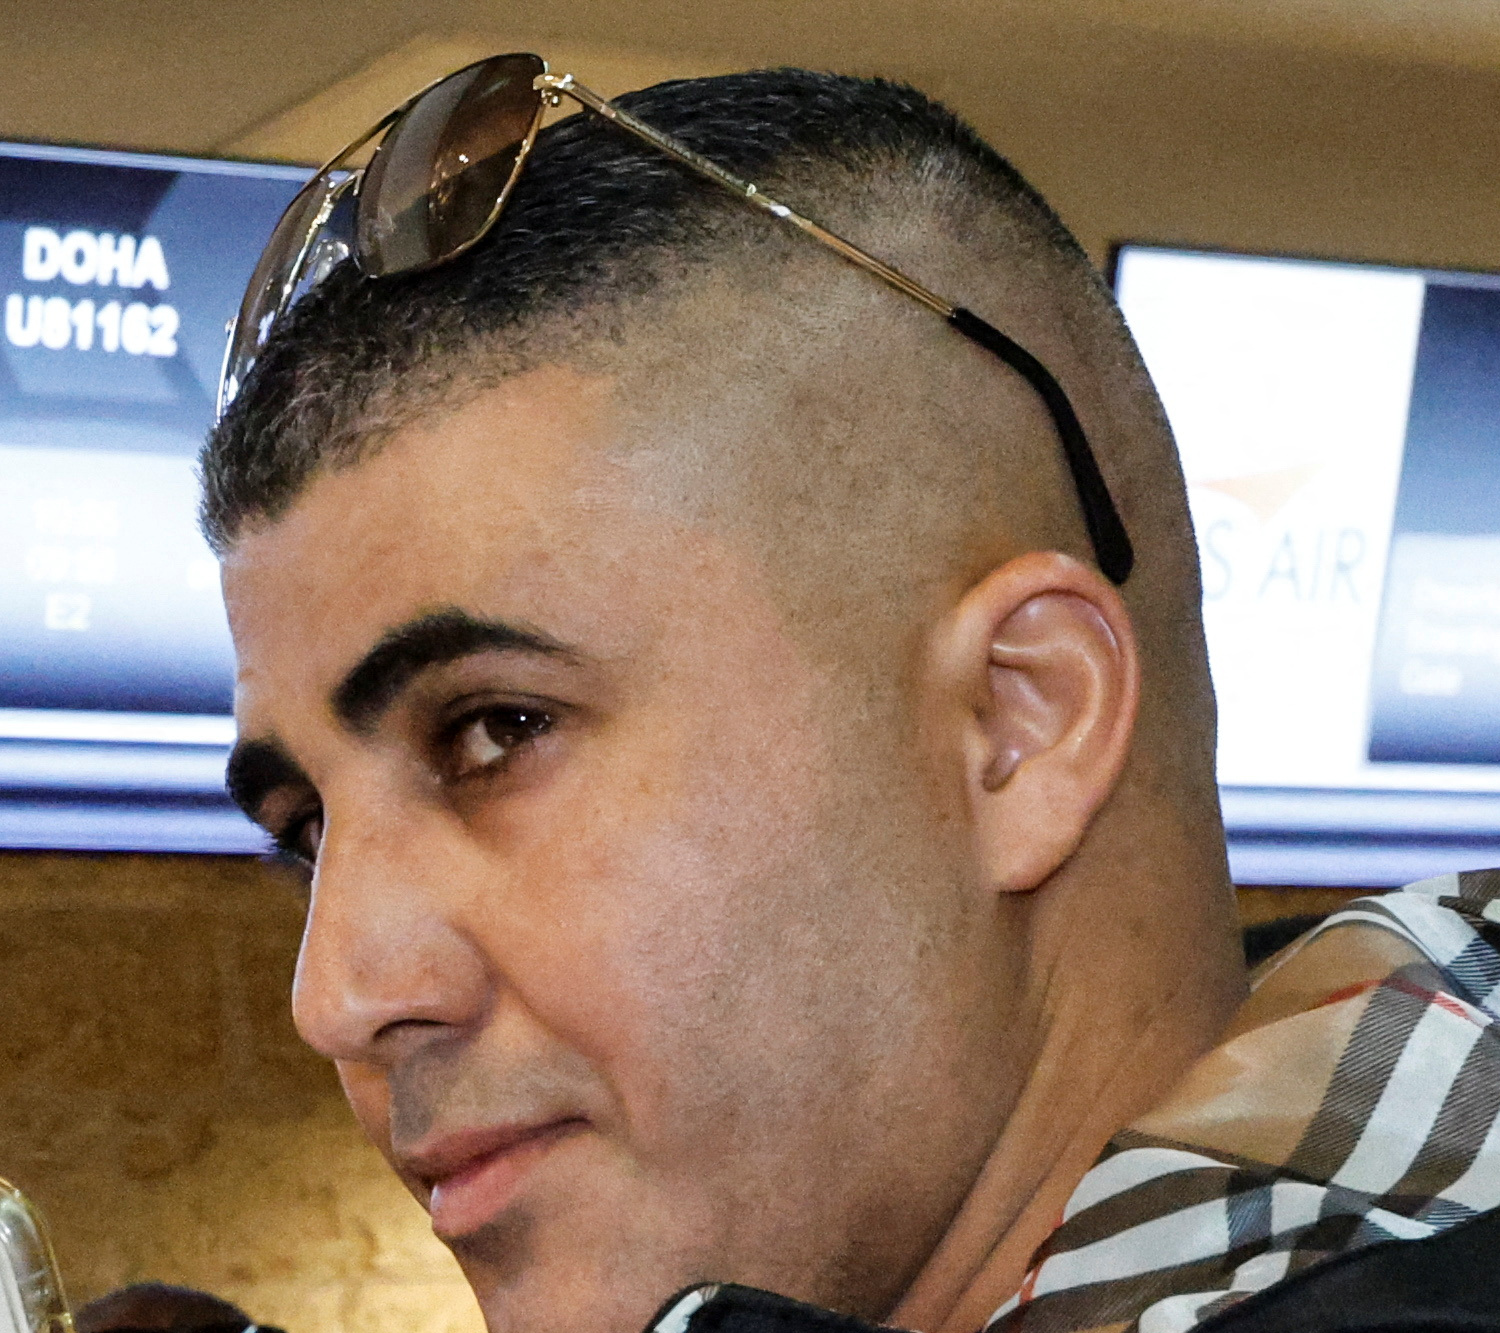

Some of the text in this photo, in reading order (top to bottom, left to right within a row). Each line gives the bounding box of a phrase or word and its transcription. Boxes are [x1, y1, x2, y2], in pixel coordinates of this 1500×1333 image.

[23, 229, 169, 289] DOHA
[5, 295, 179, 356] U81162
[1256, 524, 1368, 605] AIR
